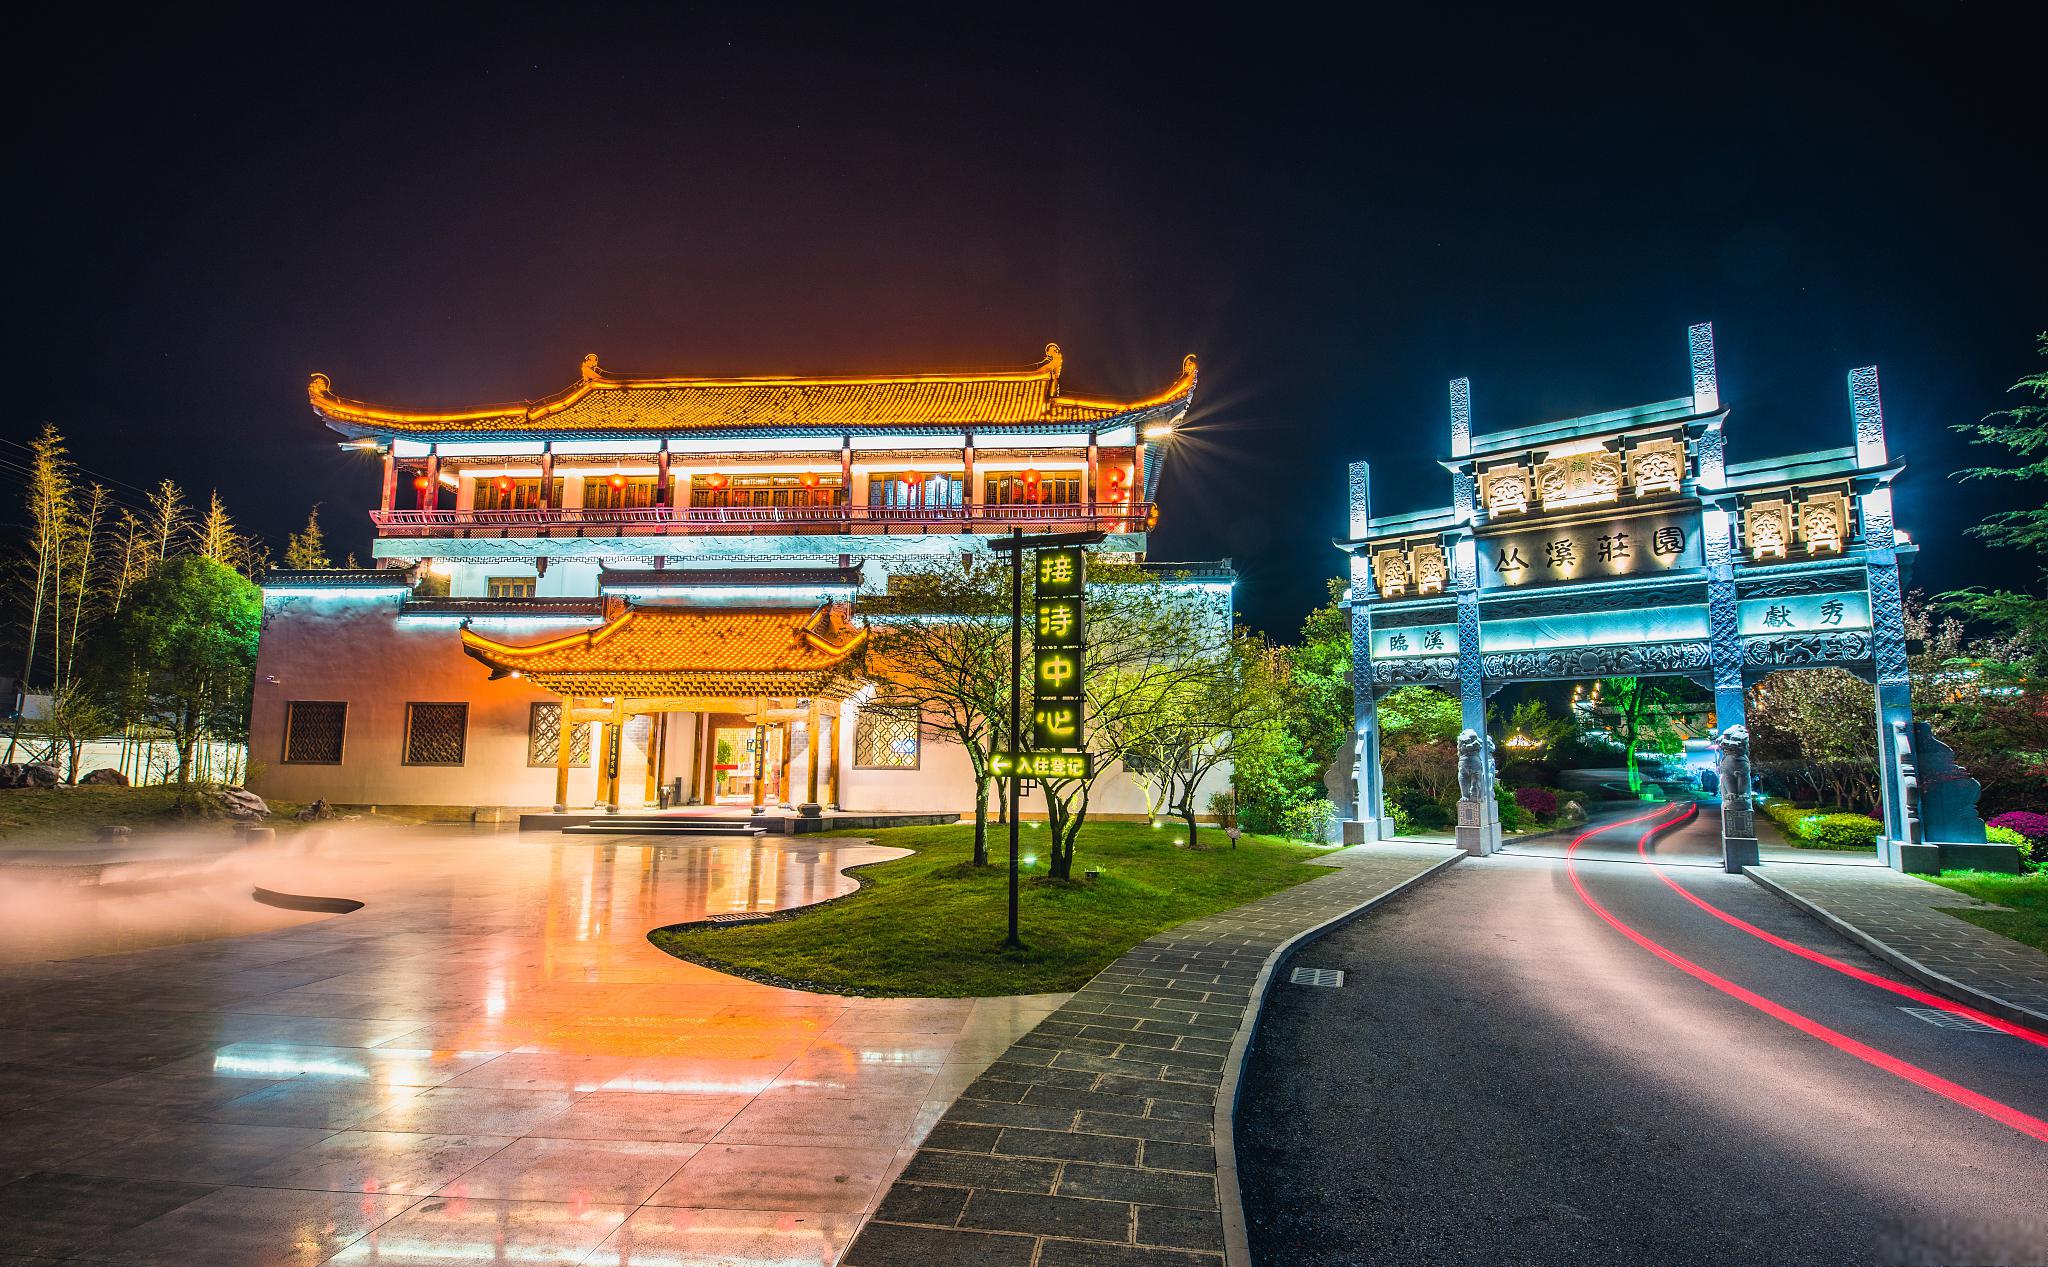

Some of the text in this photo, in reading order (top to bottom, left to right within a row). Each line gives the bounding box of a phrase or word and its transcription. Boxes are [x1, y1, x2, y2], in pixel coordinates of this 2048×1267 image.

[1037, 555, 1074, 737] 接待中心
[1390, 629, 1444, 651] 臨溪
[1017, 756, 1084, 776] 入住登记
